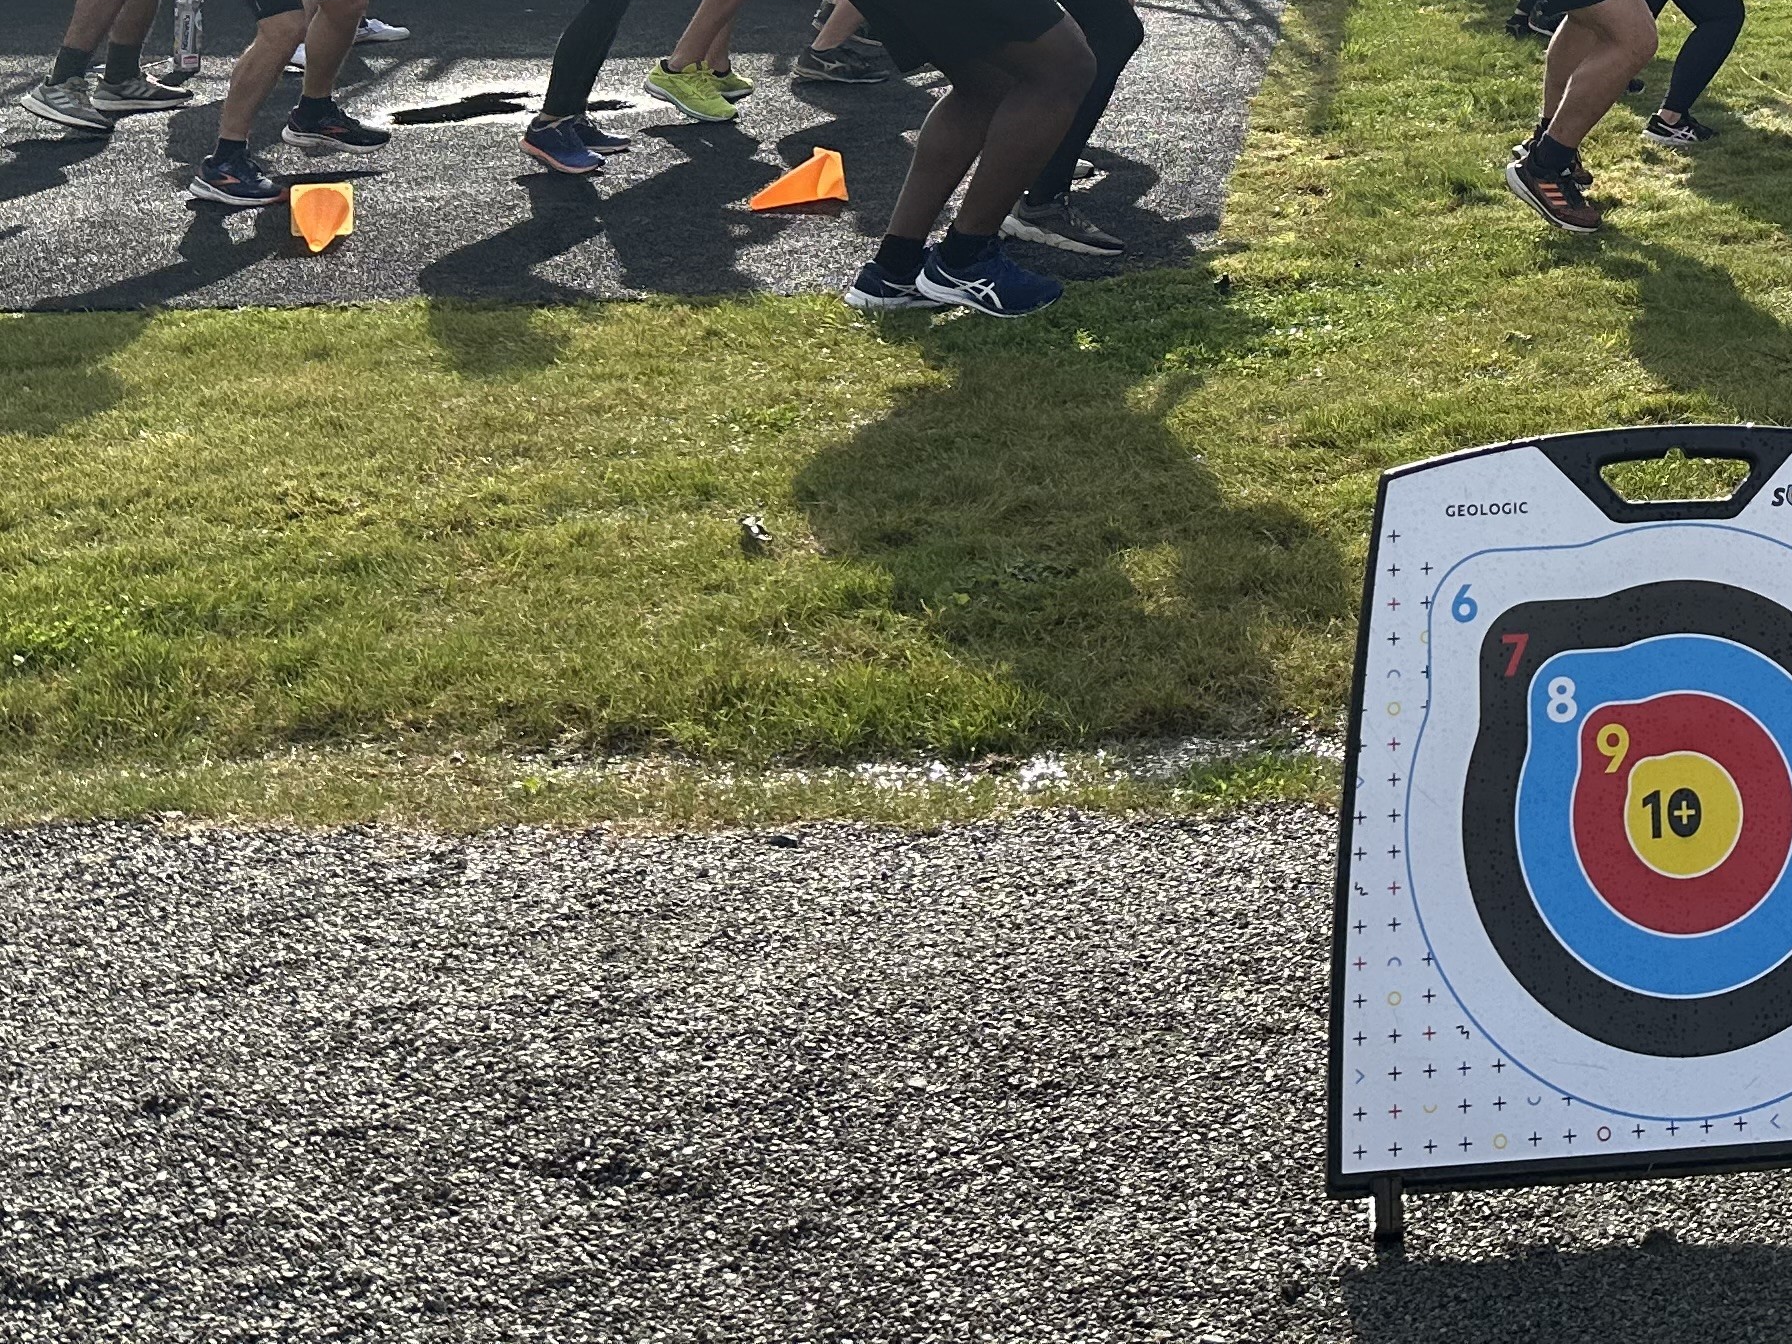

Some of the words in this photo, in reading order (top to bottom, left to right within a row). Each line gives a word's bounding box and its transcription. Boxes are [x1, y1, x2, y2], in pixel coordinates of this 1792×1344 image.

[1445, 501, 1529, 517] GEOLOGIC
[1451, 584, 1478, 623] 6
[1501, 633, 1530, 676] 7
[1546, 676, 1577, 722] 8
[1596, 723, 1630, 773] 9
